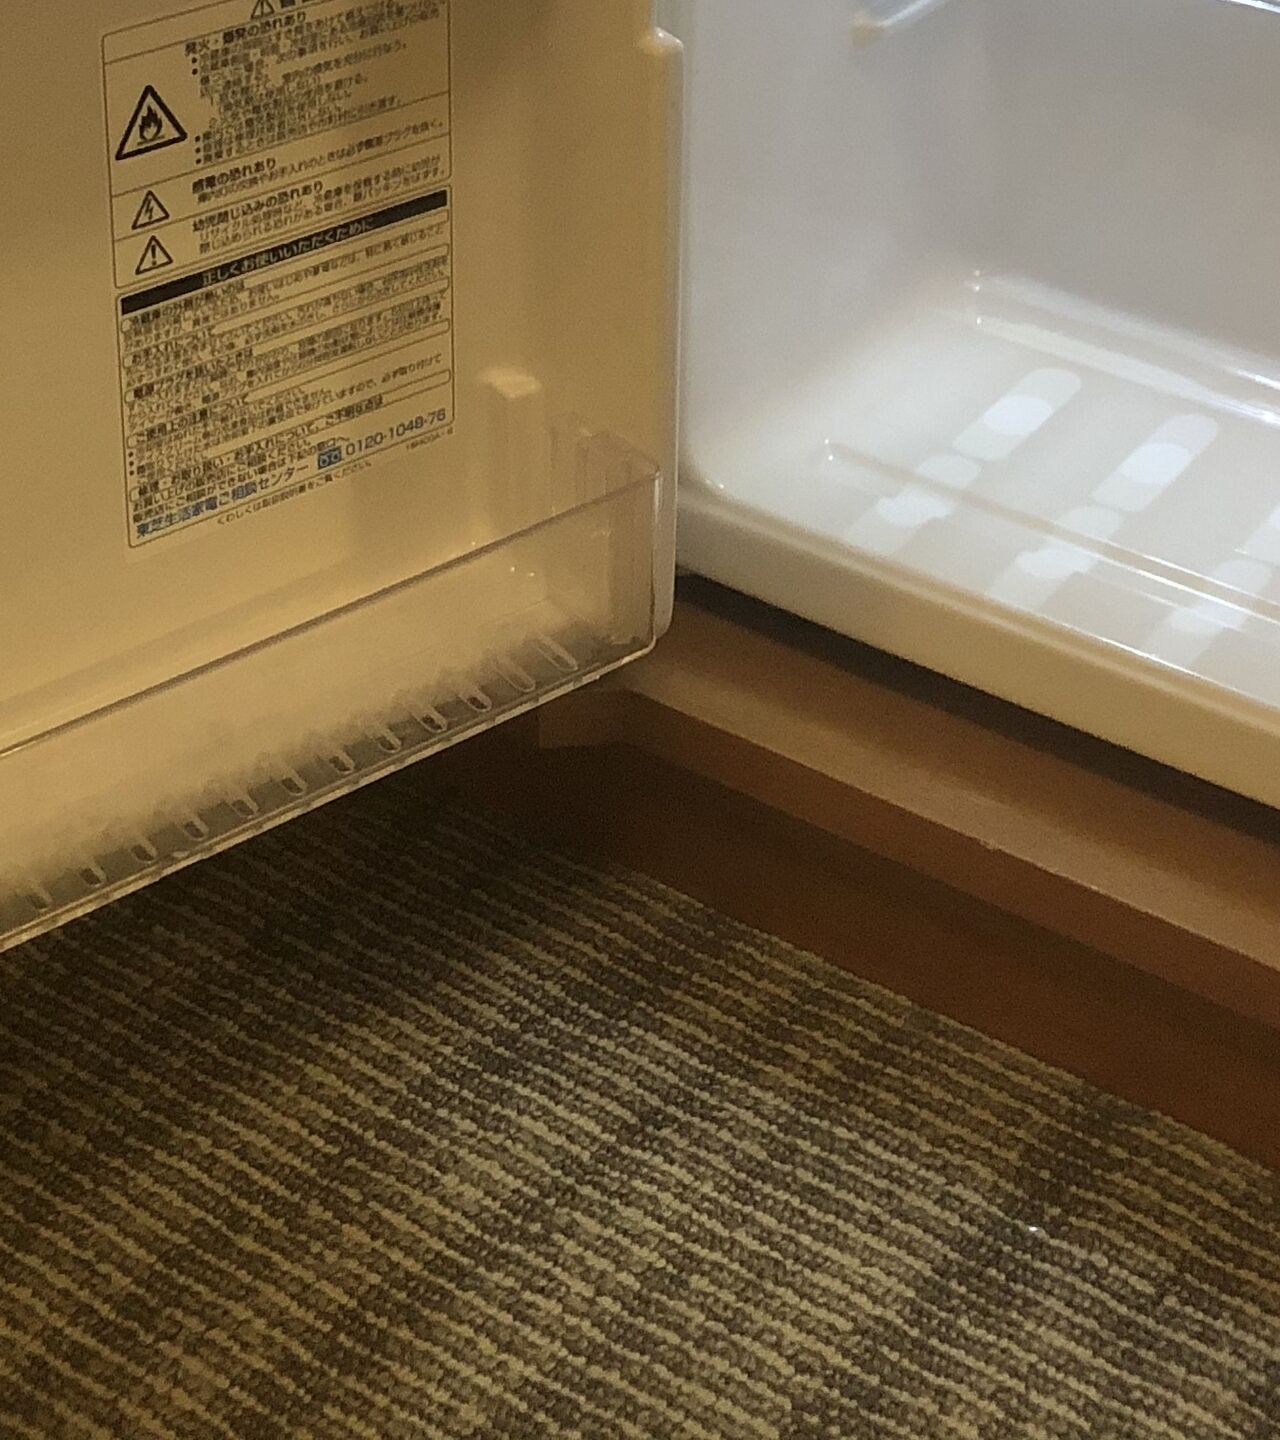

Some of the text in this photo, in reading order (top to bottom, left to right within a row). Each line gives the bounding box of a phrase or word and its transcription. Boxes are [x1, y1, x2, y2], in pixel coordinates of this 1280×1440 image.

[203, 216, 373, 285] 正しくお使いいただくために
